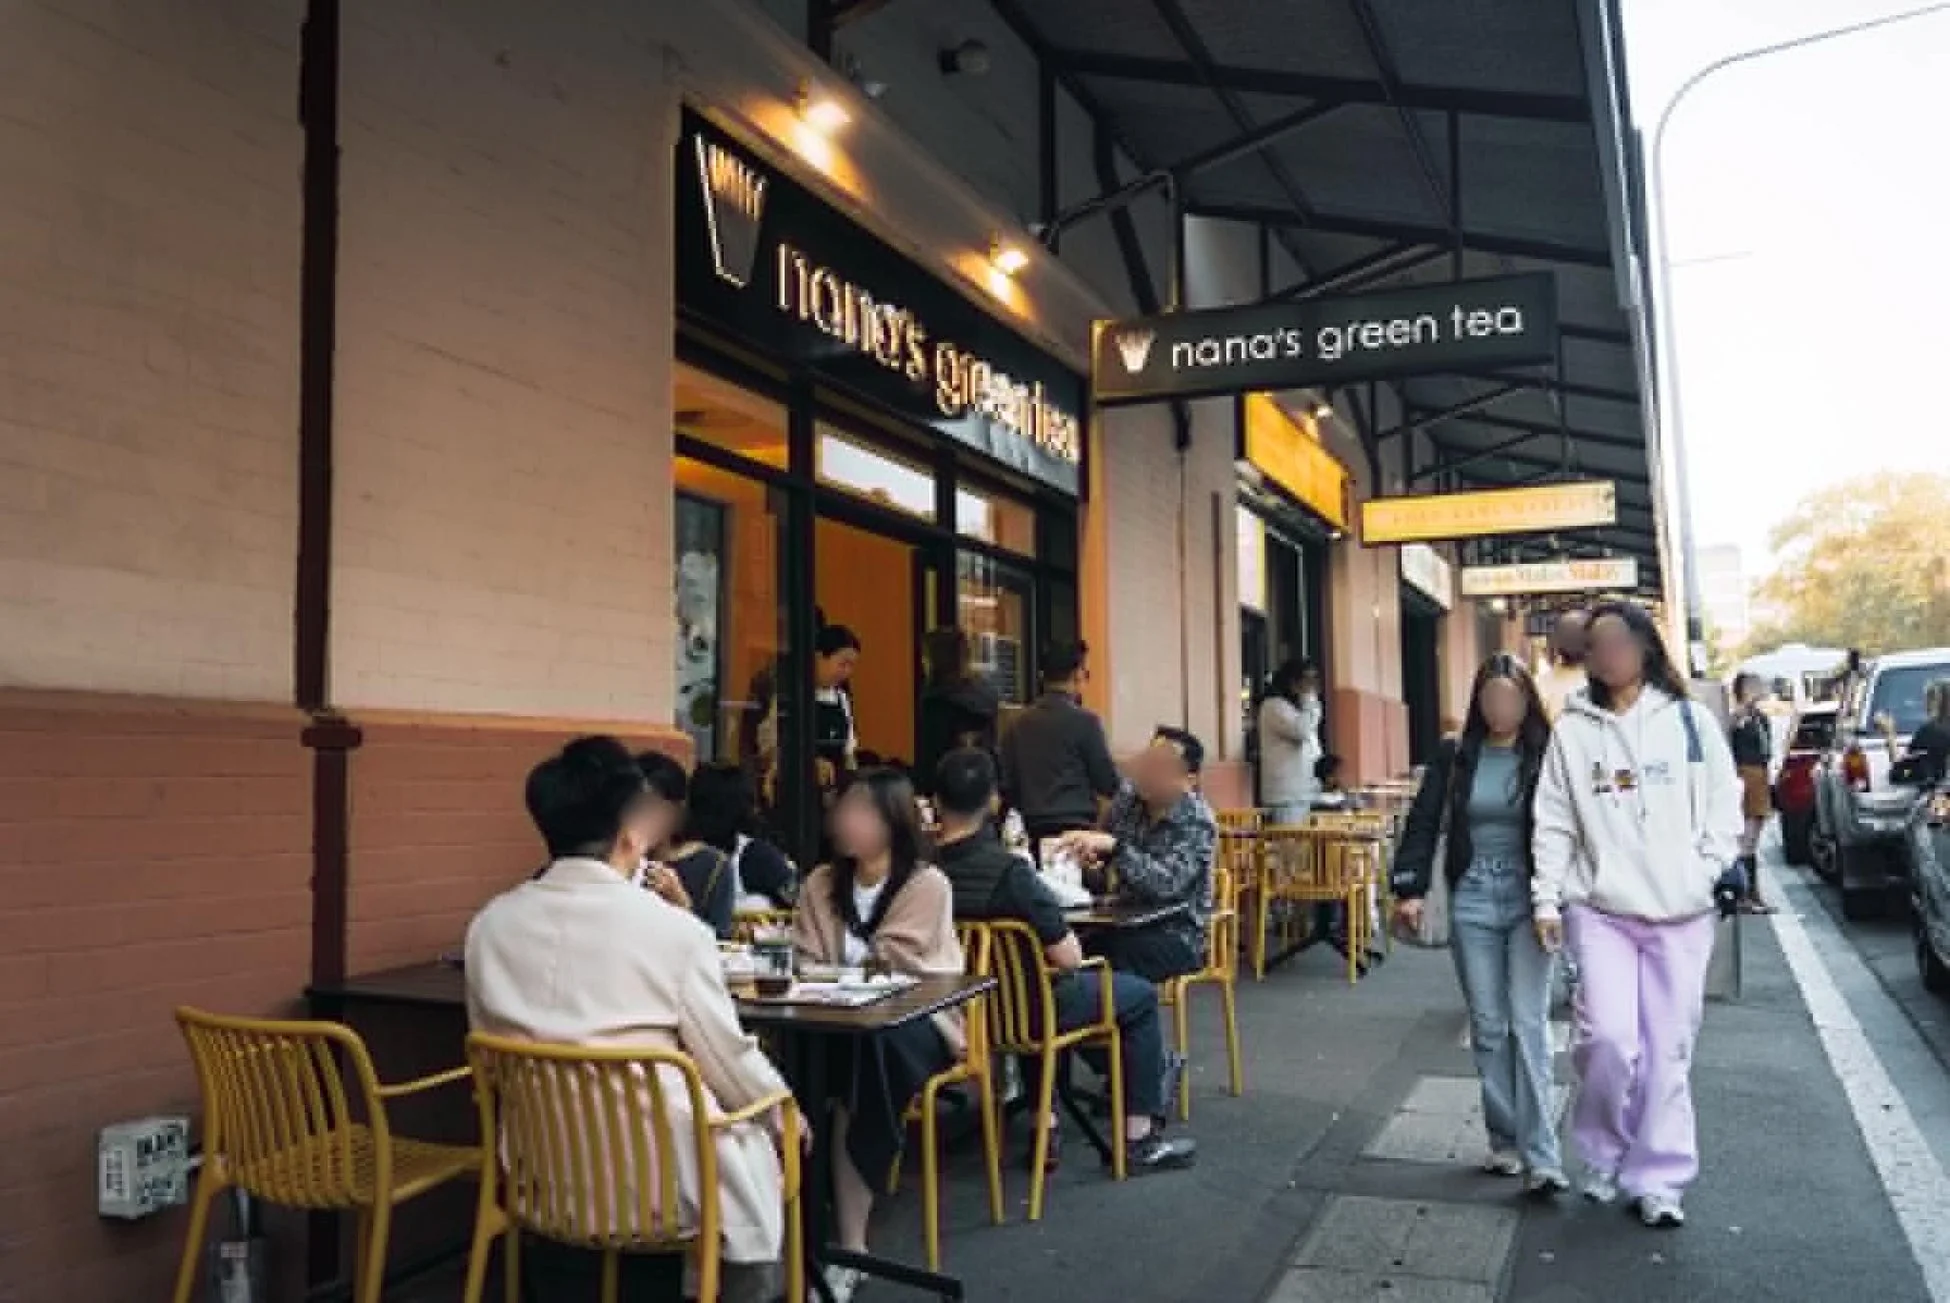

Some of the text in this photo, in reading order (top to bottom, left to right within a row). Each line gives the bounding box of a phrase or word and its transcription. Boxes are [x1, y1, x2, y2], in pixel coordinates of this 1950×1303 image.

[777, 243, 1079, 465] nana's green tea
[1172, 304, 1523, 371] nana's green tea
